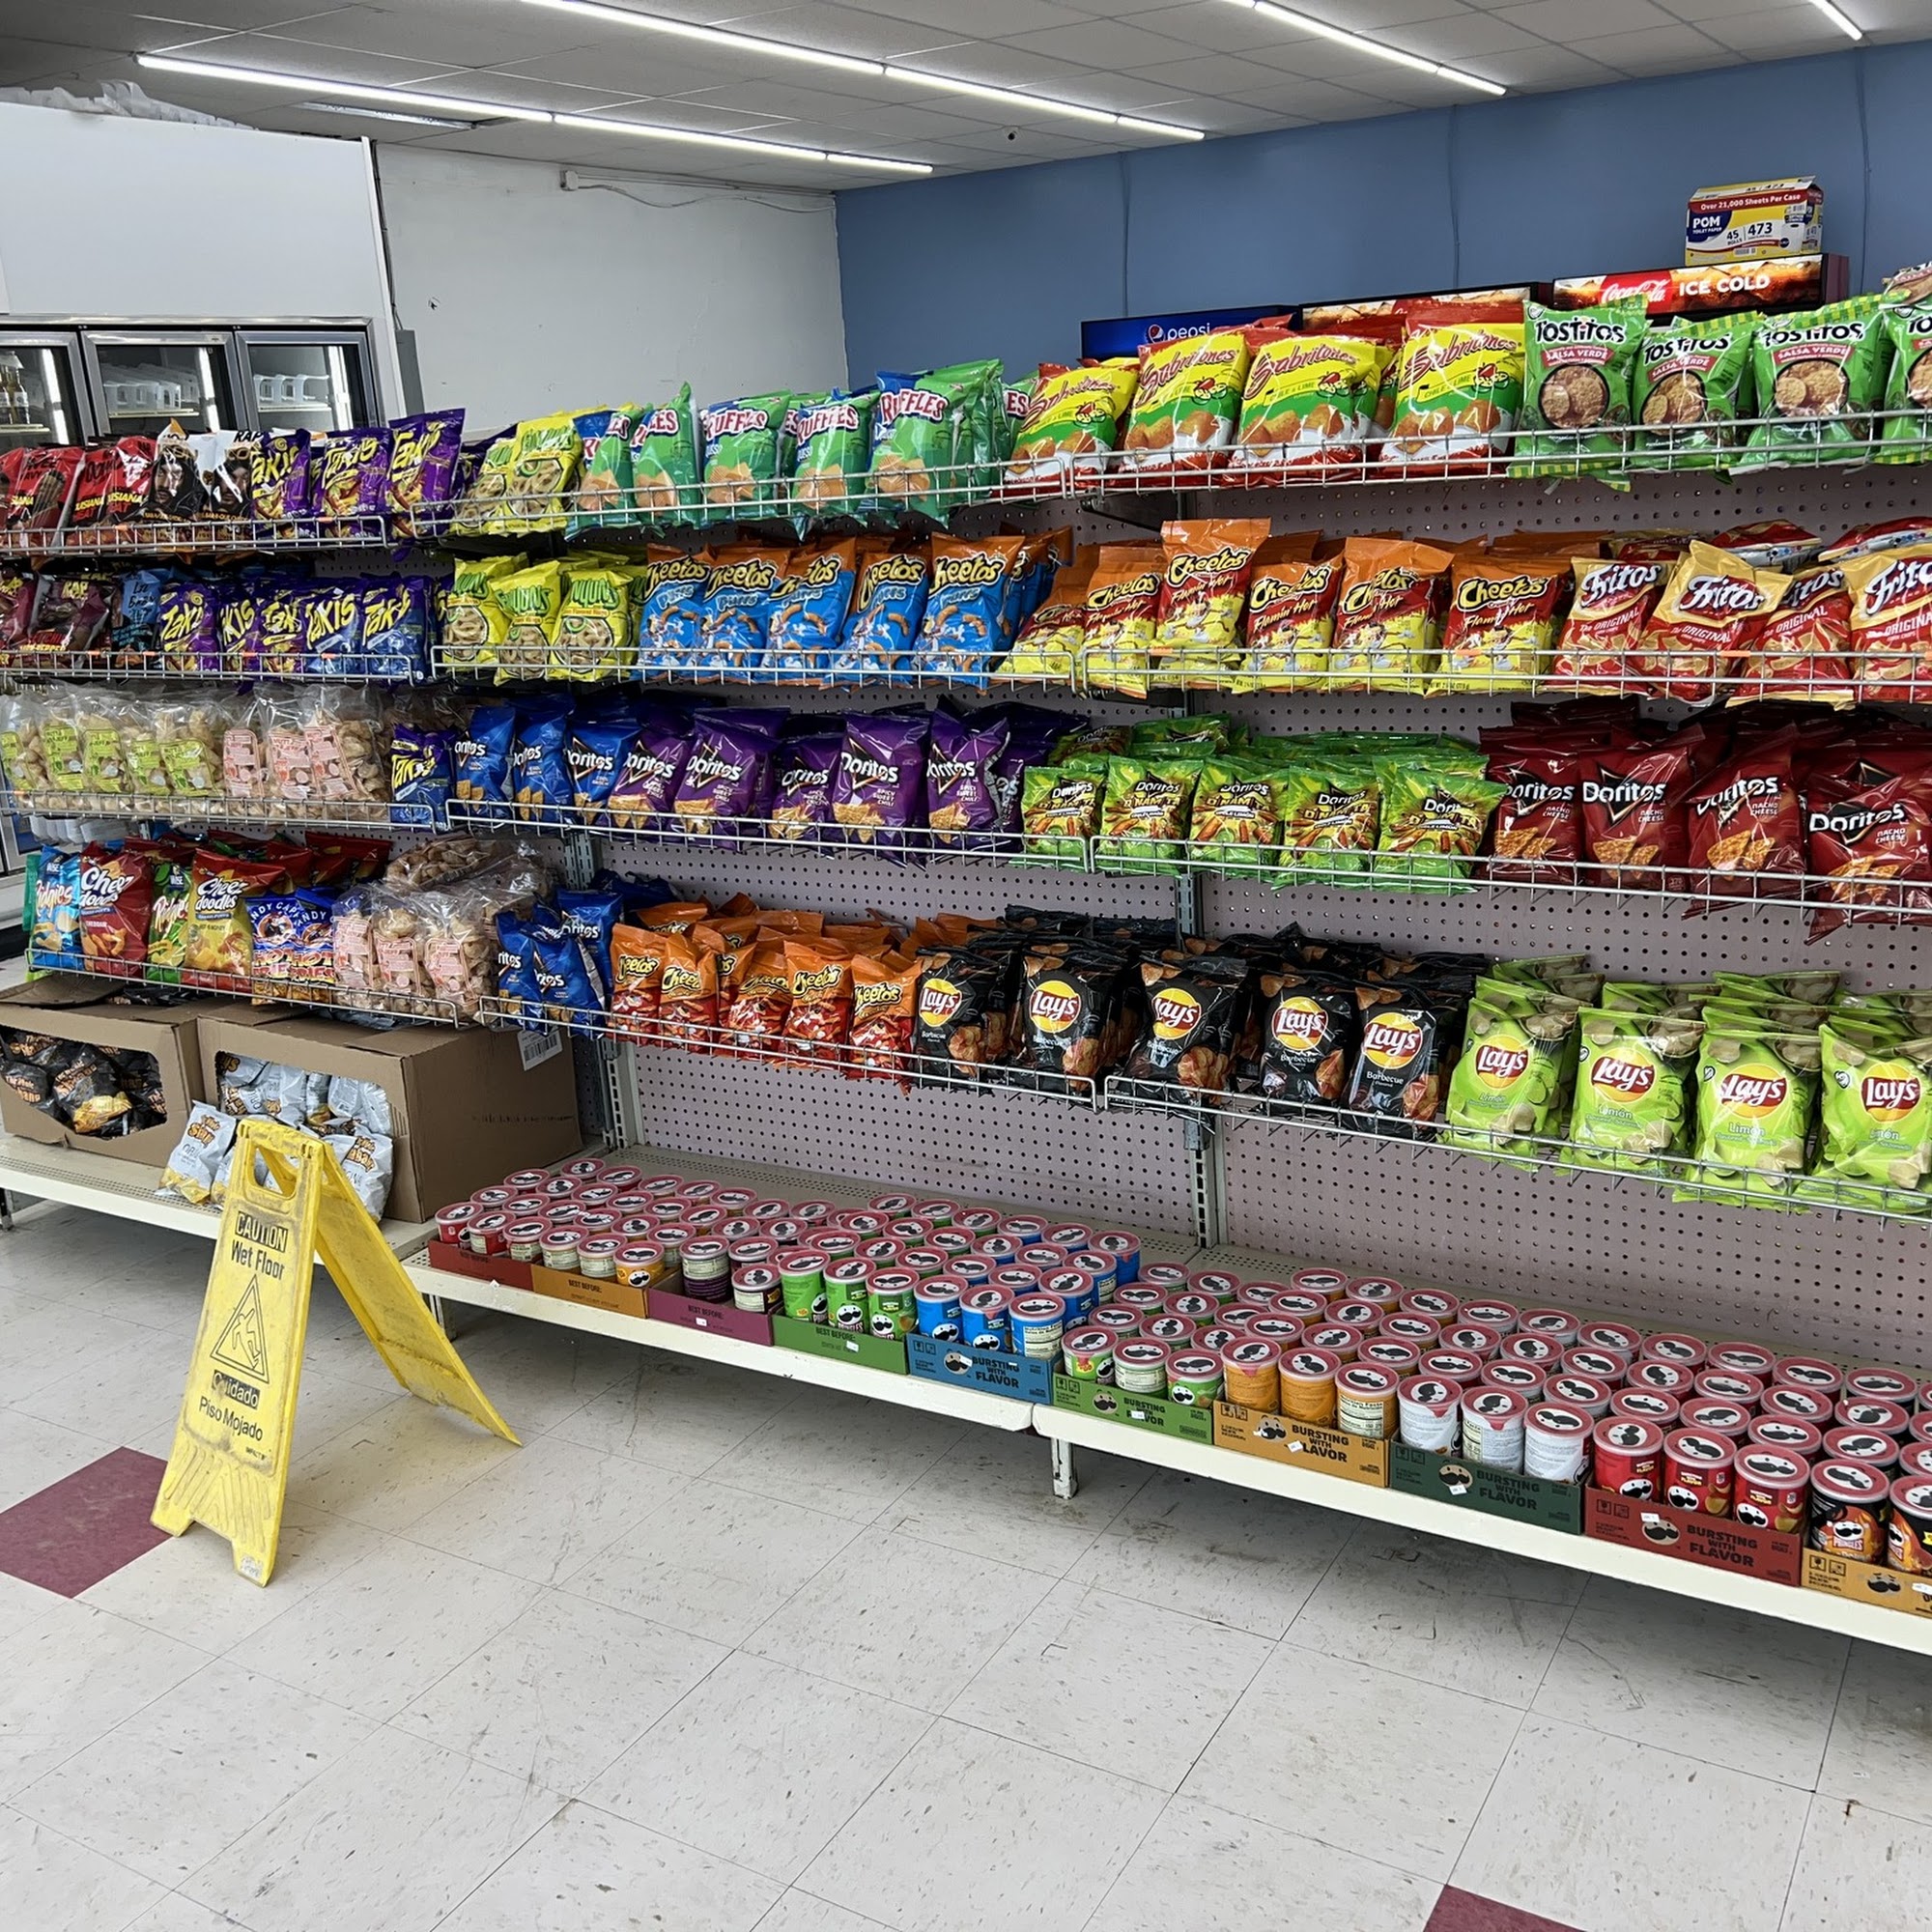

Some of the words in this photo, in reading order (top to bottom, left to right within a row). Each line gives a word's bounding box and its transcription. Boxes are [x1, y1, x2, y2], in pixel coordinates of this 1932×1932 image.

[1745, 196, 1769, 206] Sheets
[1692, 216, 1720, 228] POM
[1748, 222, 1772, 236] 473
[1727, 230, 1739, 240] 45
[1679, 281, 1710, 296] ICE
[1718, 274, 1770, 293] COLD
[1167, 323, 1210, 341] pepsi
[1398, 334, 1519, 392] Sabritones
[1548, 350, 1574, 360] SALSA
[1577, 349, 1607, 359] VERDE
[1777, 347, 1808, 359] SALSA
[1811, 346, 1850, 356] VERDE
[1243, 345, 1357, 400] Sabritones
[1652, 362, 1677, 378] SALSA
[1453, 375, 1471, 387] LIME
[880, 389, 948, 425] RUFFLES
[1169, 549, 1250, 585] Cheetos
[1089, 575, 1157, 608] Cheetos
[1251, 567, 1329, 610] Cheetos
[1459, 576, 1548, 610] Cheetos
[1581, 564, 1662, 608] Fritos
[1680, 575, 1764, 611] Fritos
[1293, 599, 1318, 611] Hot
[1595, 607, 1639, 630] ORIGINAL
[1776, 605, 1828, 633] ORIGINAL
[1682, 625, 1732, 643] ORIGINAL
[686, 755, 743, 781] Doritos
[840, 753, 898, 783] Doritos
[1135, 781, 1179, 793] Doritos
[1319, 790, 1366, 805] Doritos
[1583, 781, 1666, 803] Doritos
[1810, 804, 1905, 832] Doritos
[1875, 835, 1907, 844] CHEESE
[1877, 828, 1906, 837] NACHO
[81, 868, 134, 895] Cheez
[198, 879, 248, 896] Cheez
[1365, 1027, 1420, 1057] Lay's
[1280, 1054, 1317, 1064] Barbecue
[1478, 1046, 1528, 1078] Lay's
[1366, 1070, 1405, 1085] Barbecue
[1594, 1058, 1654, 1092] Lay's
[1721, 1074, 1784, 1106] Lay's
[1867, 1077, 1918, 1110] Lay's
[236, 1213, 287, 1251] CAUTION
[232, 1239, 253, 1266] Wet
[256, 1251, 285, 1280] Floor
[568, 1279, 580, 1288] BEST
[688, 1304, 703, 1314] BEST
[816, 1327, 831, 1337] BEST
[973, 1356, 1020, 1373] BURSTING
[992, 1367, 1007, 1377] WITH
[976, 1371, 1019, 1388] FLAVOR
[1123, 1397, 1165, 1413] BURSTING
[199, 1396, 222, 1425] Piso
[223, 1410, 263, 1441] Mojado
[1292, 1425, 1350, 1446] BURSTING
[1309, 1437, 1332, 1450] WITH
[1477, 1470, 1540, 1493] BURSTING
[1495, 1484, 1520, 1496] WITH
[1479, 1487, 1537, 1511] FLAVOR
[1687, 1524, 1758, 1549] BURSTING
[1708, 1538, 1737, 1551] WITH
[1690, 1544, 1754, 1568] FLAVOR
